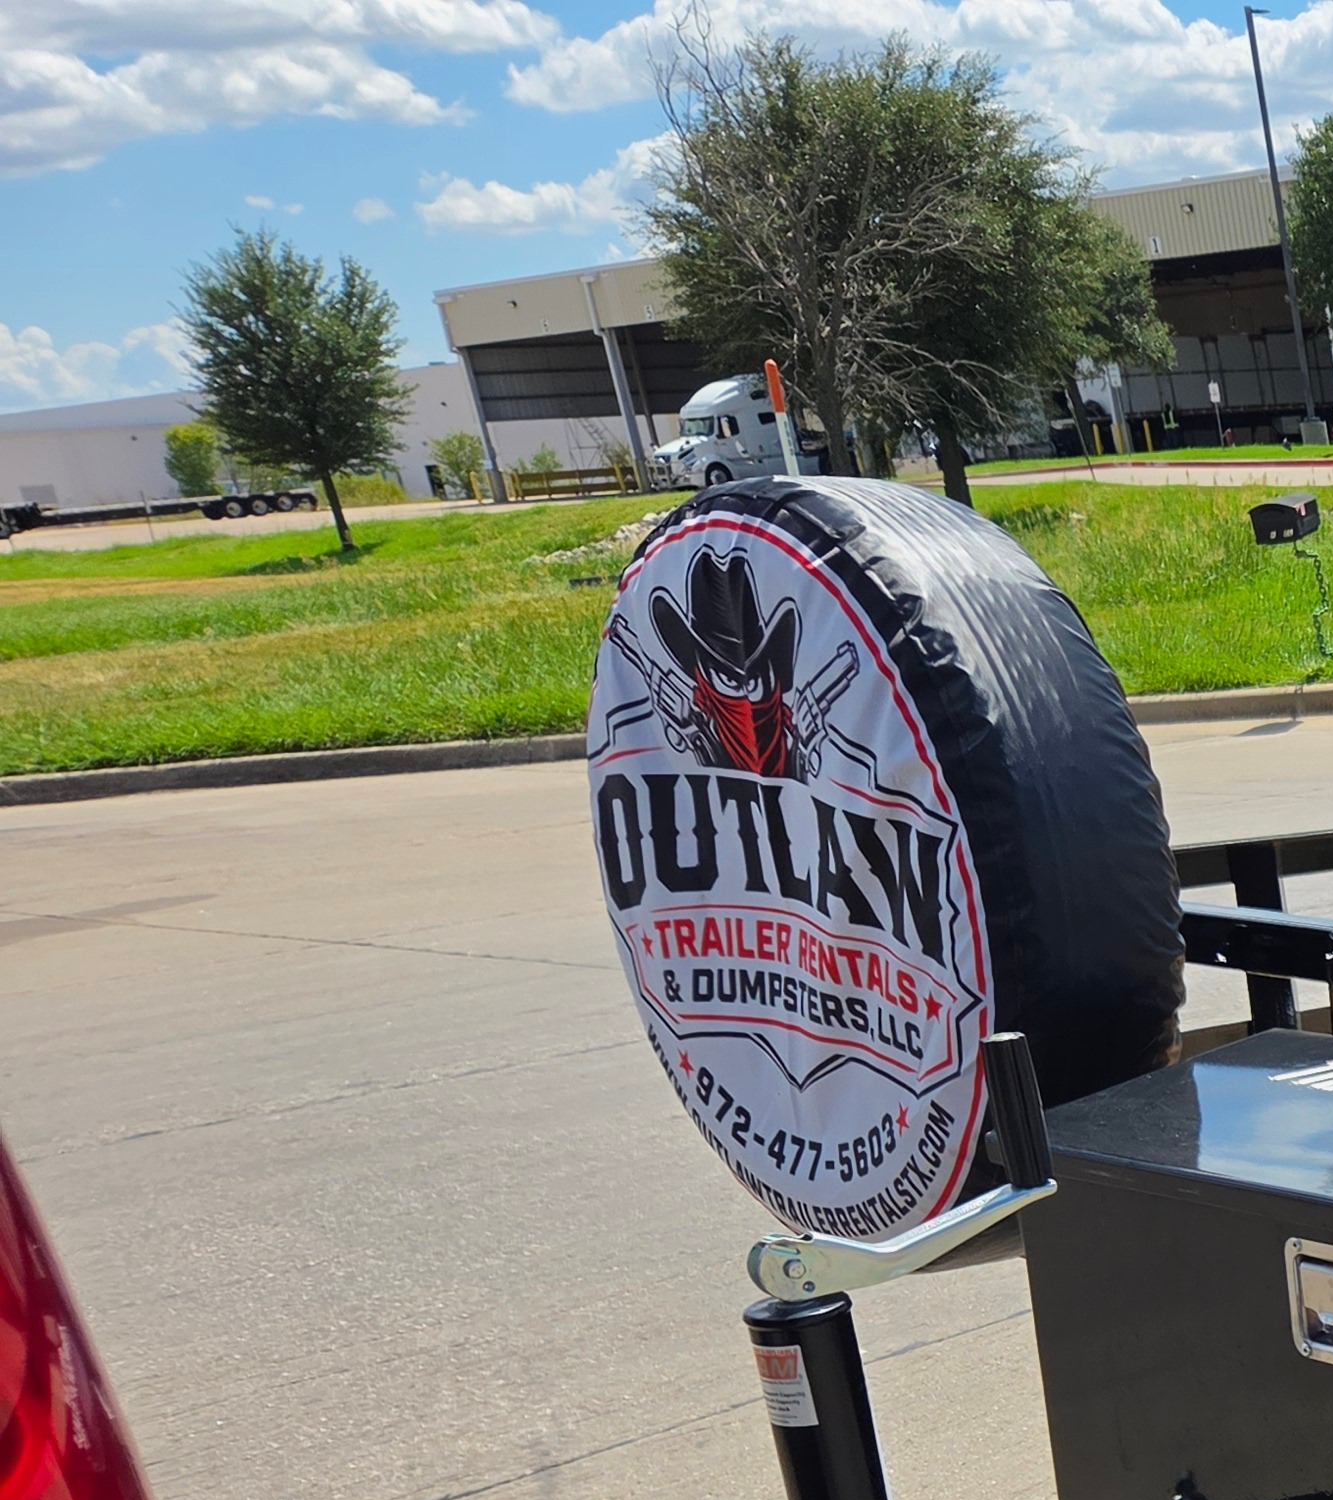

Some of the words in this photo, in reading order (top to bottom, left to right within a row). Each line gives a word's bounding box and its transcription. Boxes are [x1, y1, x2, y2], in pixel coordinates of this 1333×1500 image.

[596, 774, 947, 969] OUTLAW
[654, 917, 791, 965] TRAILER
[798, 929, 920, 1014] RENTALS
[663, 970, 683, 1003] &
[695, 1066, 898, 1183] 972-477-5603
